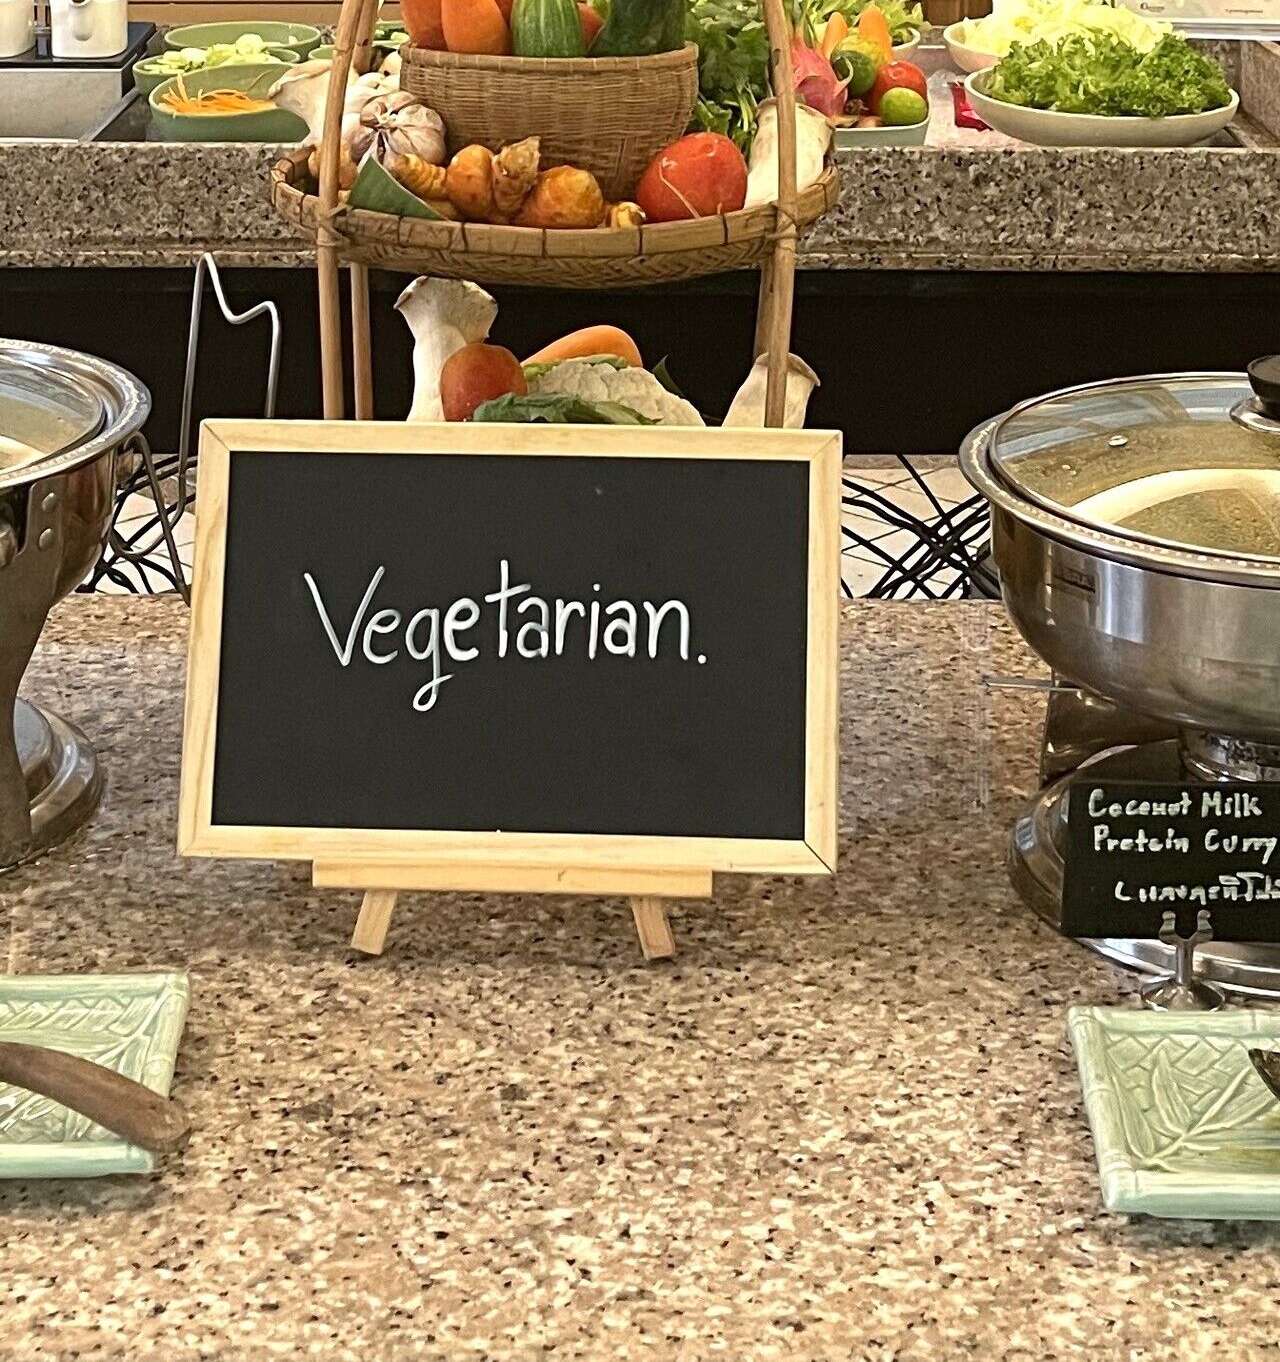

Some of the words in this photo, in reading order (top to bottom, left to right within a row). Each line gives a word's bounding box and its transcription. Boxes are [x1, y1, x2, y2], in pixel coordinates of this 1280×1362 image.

[303, 559, 707, 712] Vegetarian.
[1088, 788, 1193, 818] Coconut
[1201, 790, 1263, 818] Milk
[1093, 824, 1190, 853] Protein
[1204, 828, 1278, 865] Curry
